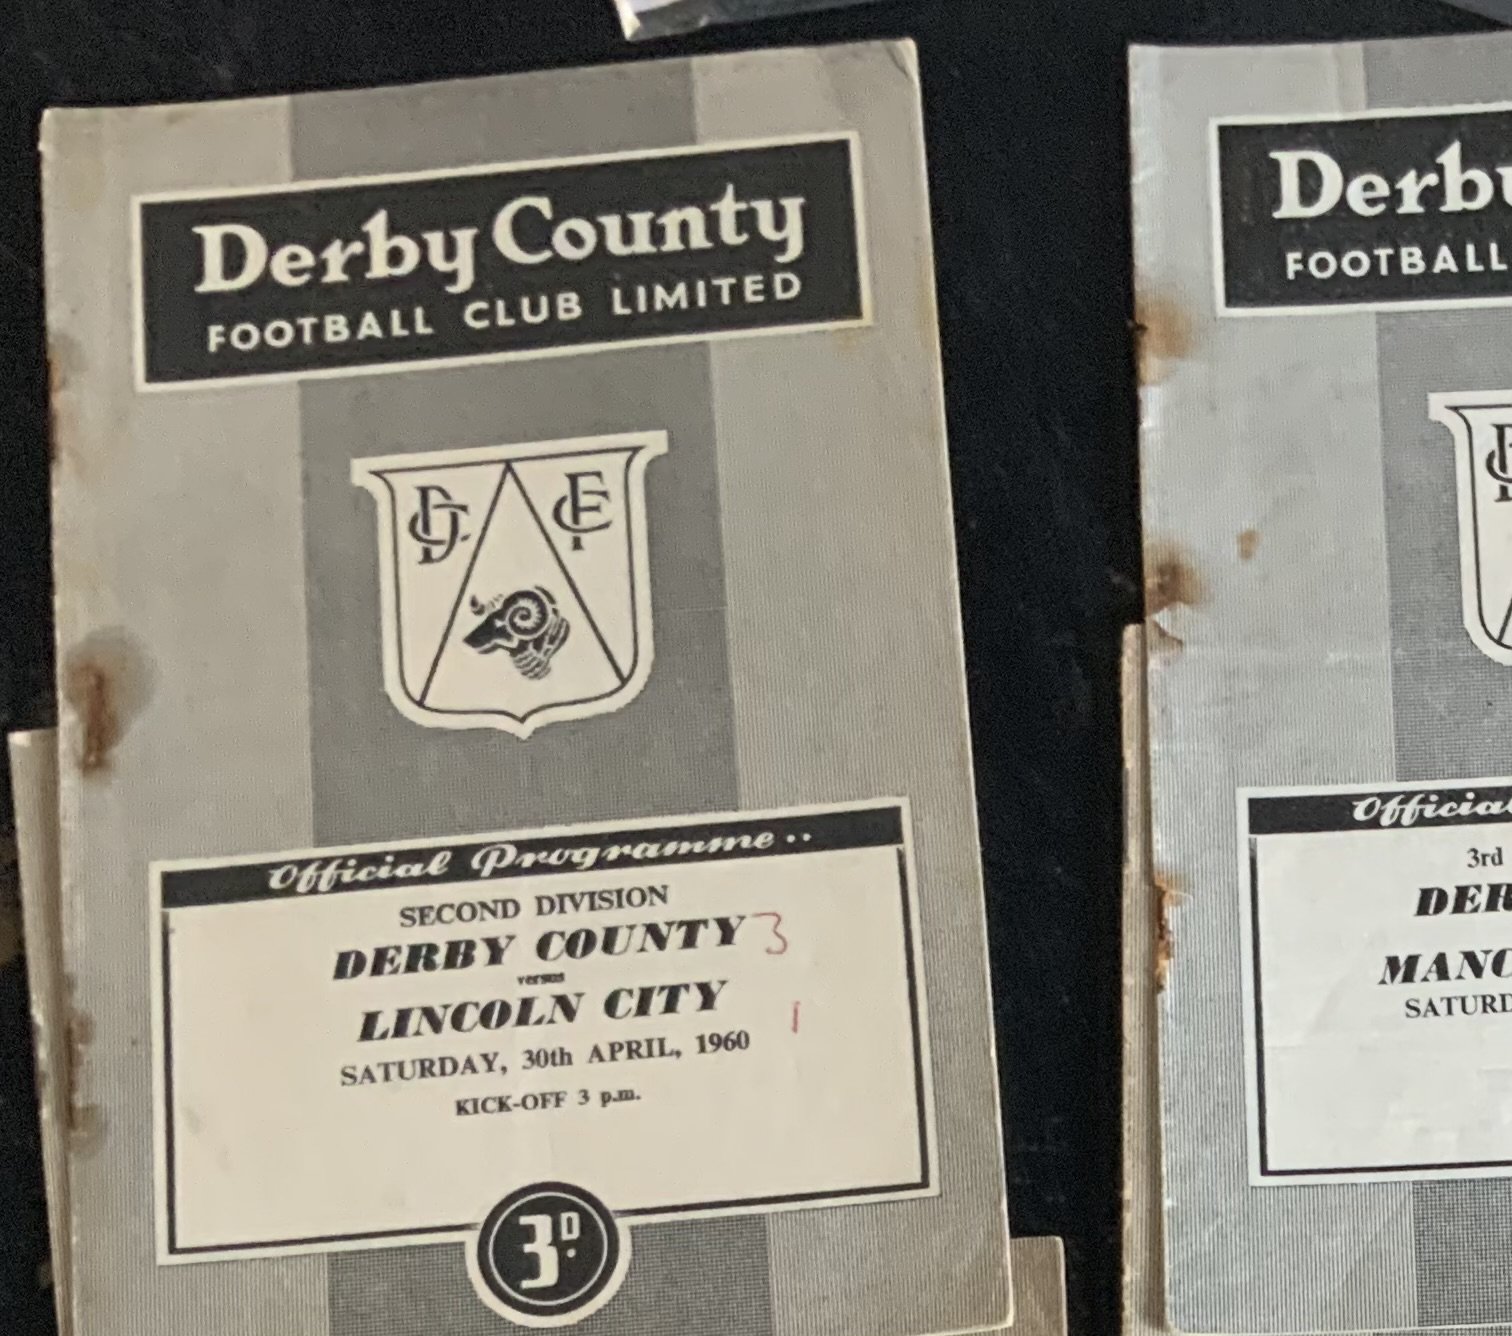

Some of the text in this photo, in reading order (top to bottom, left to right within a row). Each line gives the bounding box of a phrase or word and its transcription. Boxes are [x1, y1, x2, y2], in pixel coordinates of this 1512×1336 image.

[191, 183, 805, 294] Derby County
[1285, 242, 1508, 280] FOOTBALL
[208, 271, 802, 353] FOOTBALL CLUB LIMITED
[269, 850, 452, 894] Official
[1467, 846, 1504, 869] 3rd
[399, 884, 669, 928] SECOND DIVISION
[332, 915, 746, 980] DERBY COUNTY
[751, 911, 789, 956] 3
[357, 979, 728, 1042] LINCOLN CITY
[340, 1029, 750, 1087] SATURDAY, 30th APRIL, 1960
[455, 1088, 641, 1117] KICK-OFF 3 p.m.
